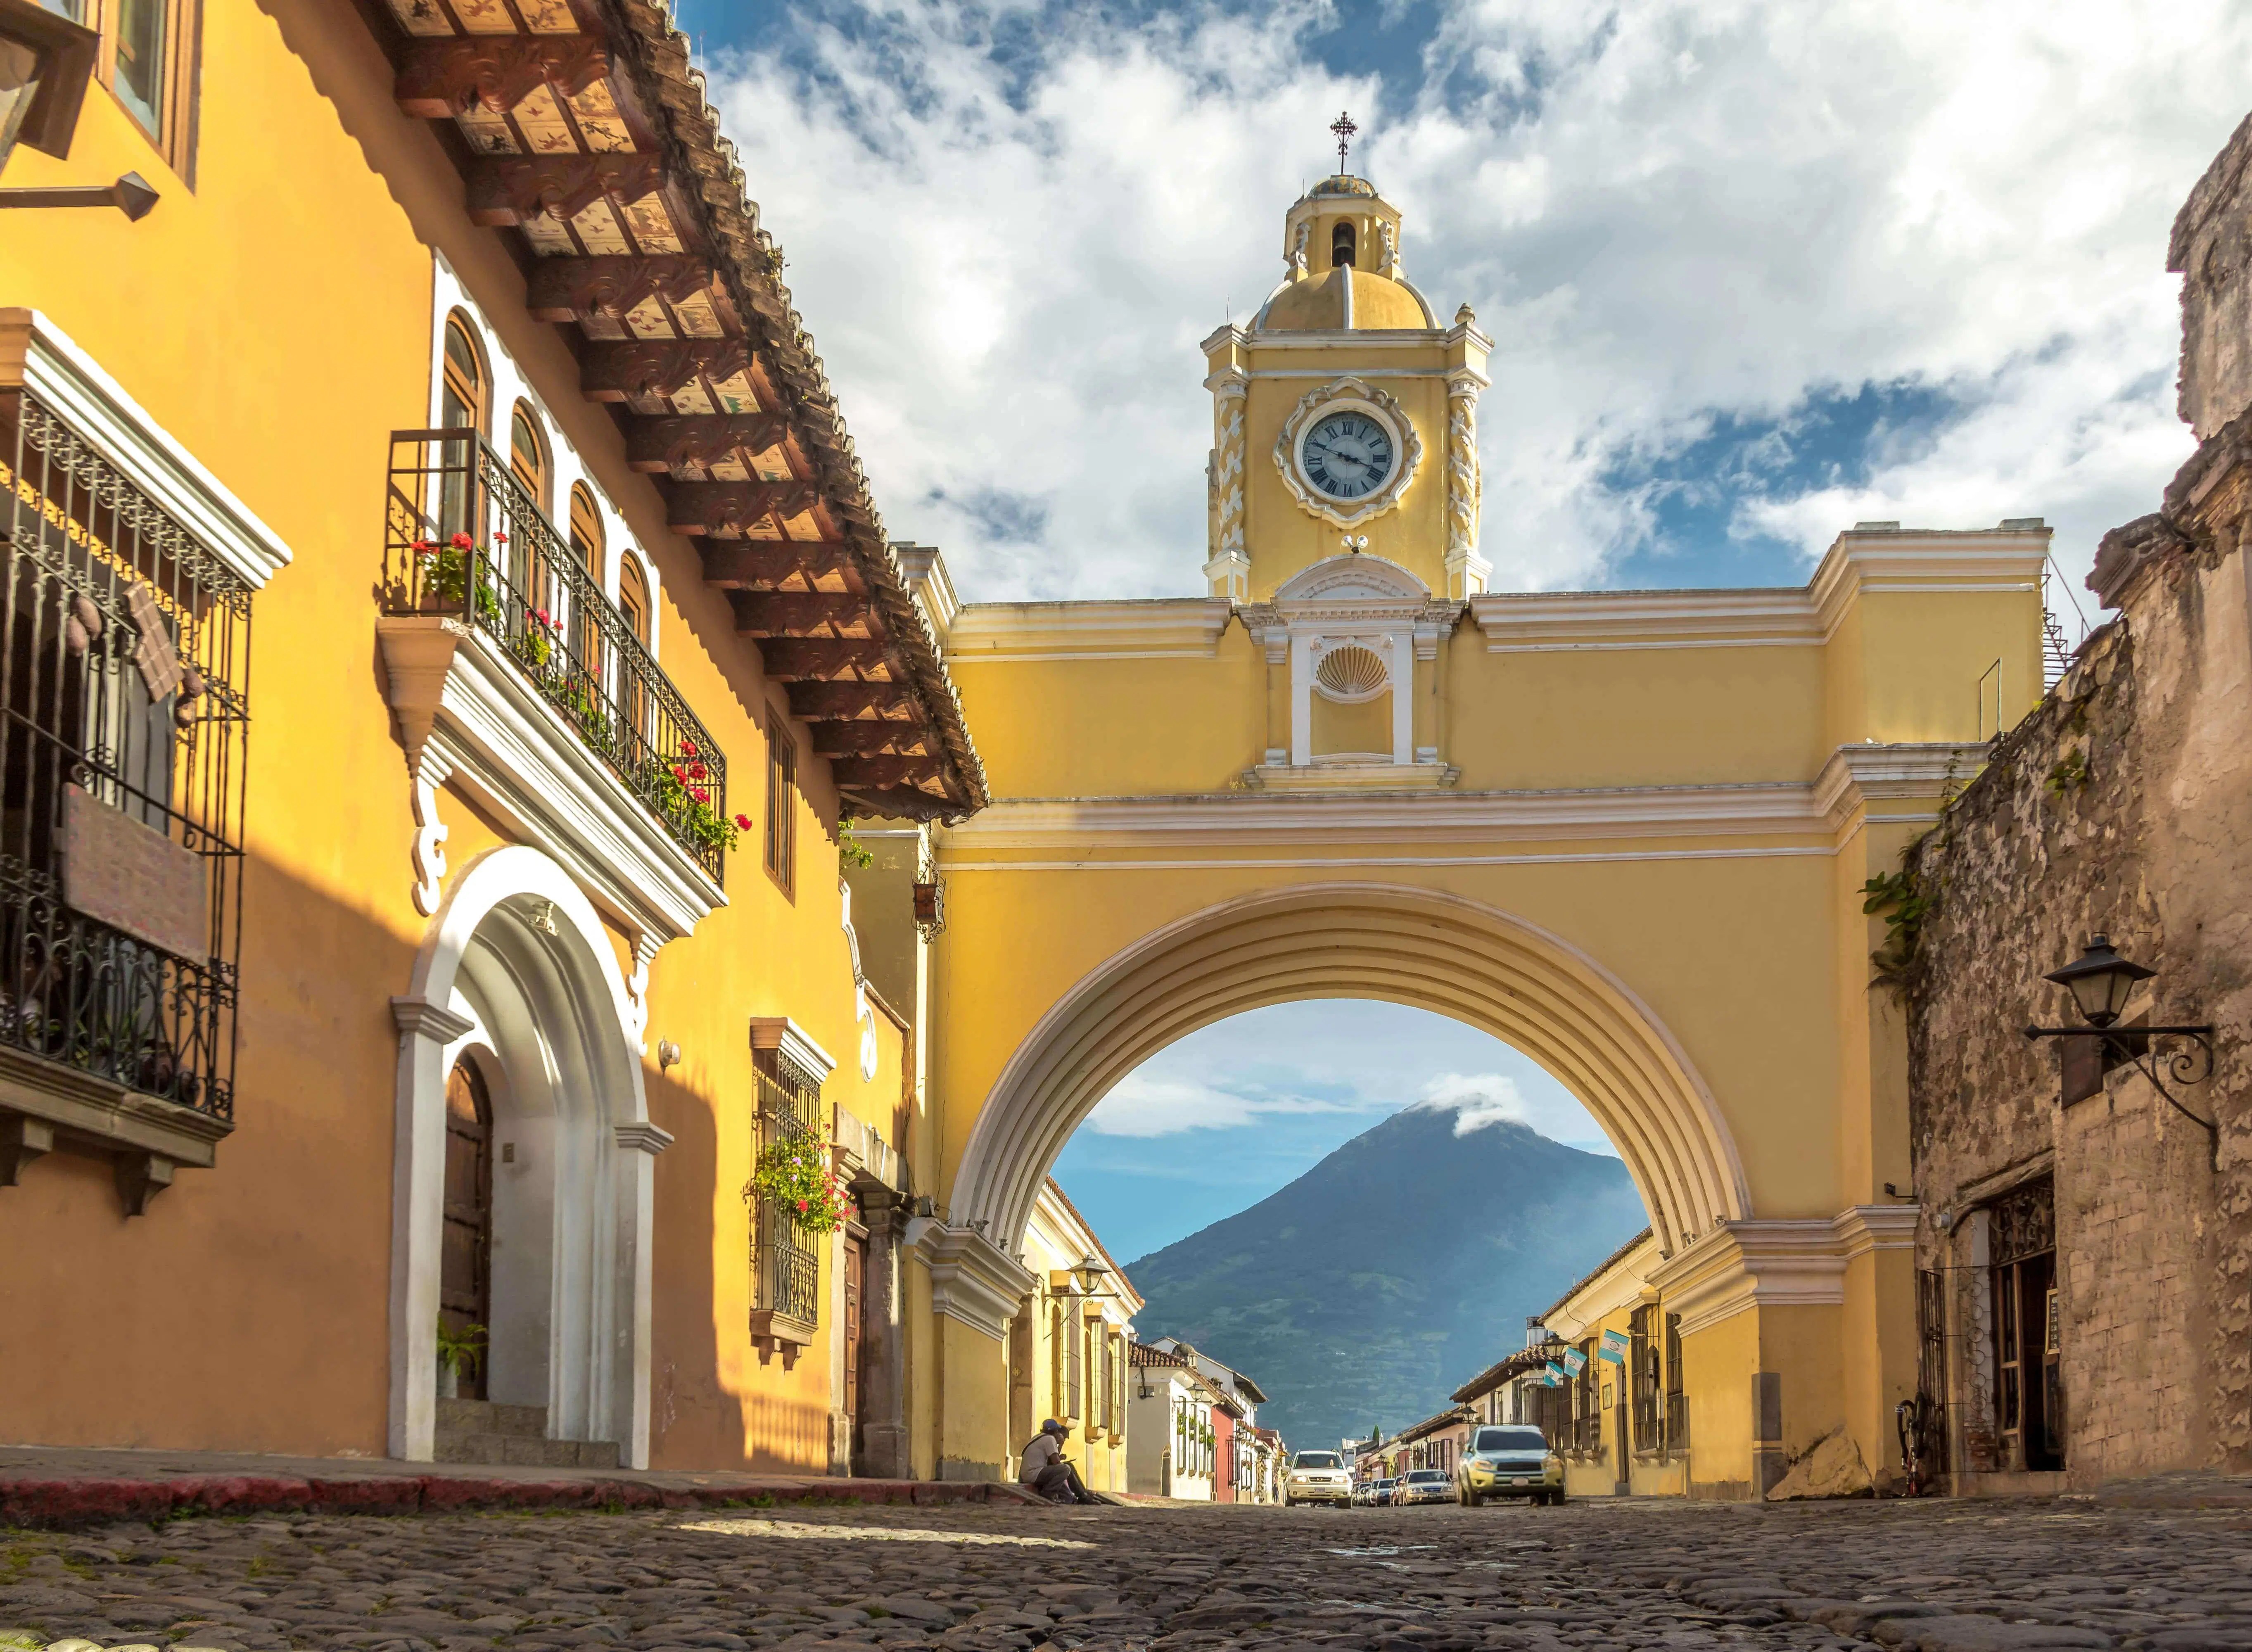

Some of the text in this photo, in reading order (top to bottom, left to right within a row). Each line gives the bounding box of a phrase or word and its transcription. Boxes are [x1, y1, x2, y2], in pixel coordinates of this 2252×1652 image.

[1324, 425, 1339, 441] XI
[1341, 421, 1354, 435] XII
[1358, 425, 1368, 439] I
[1368, 437, 1383, 449] II
[1308, 455, 1322, 465] IX
[1373, 454, 1387, 463] III
[1343, 483, 1353, 497] VI
